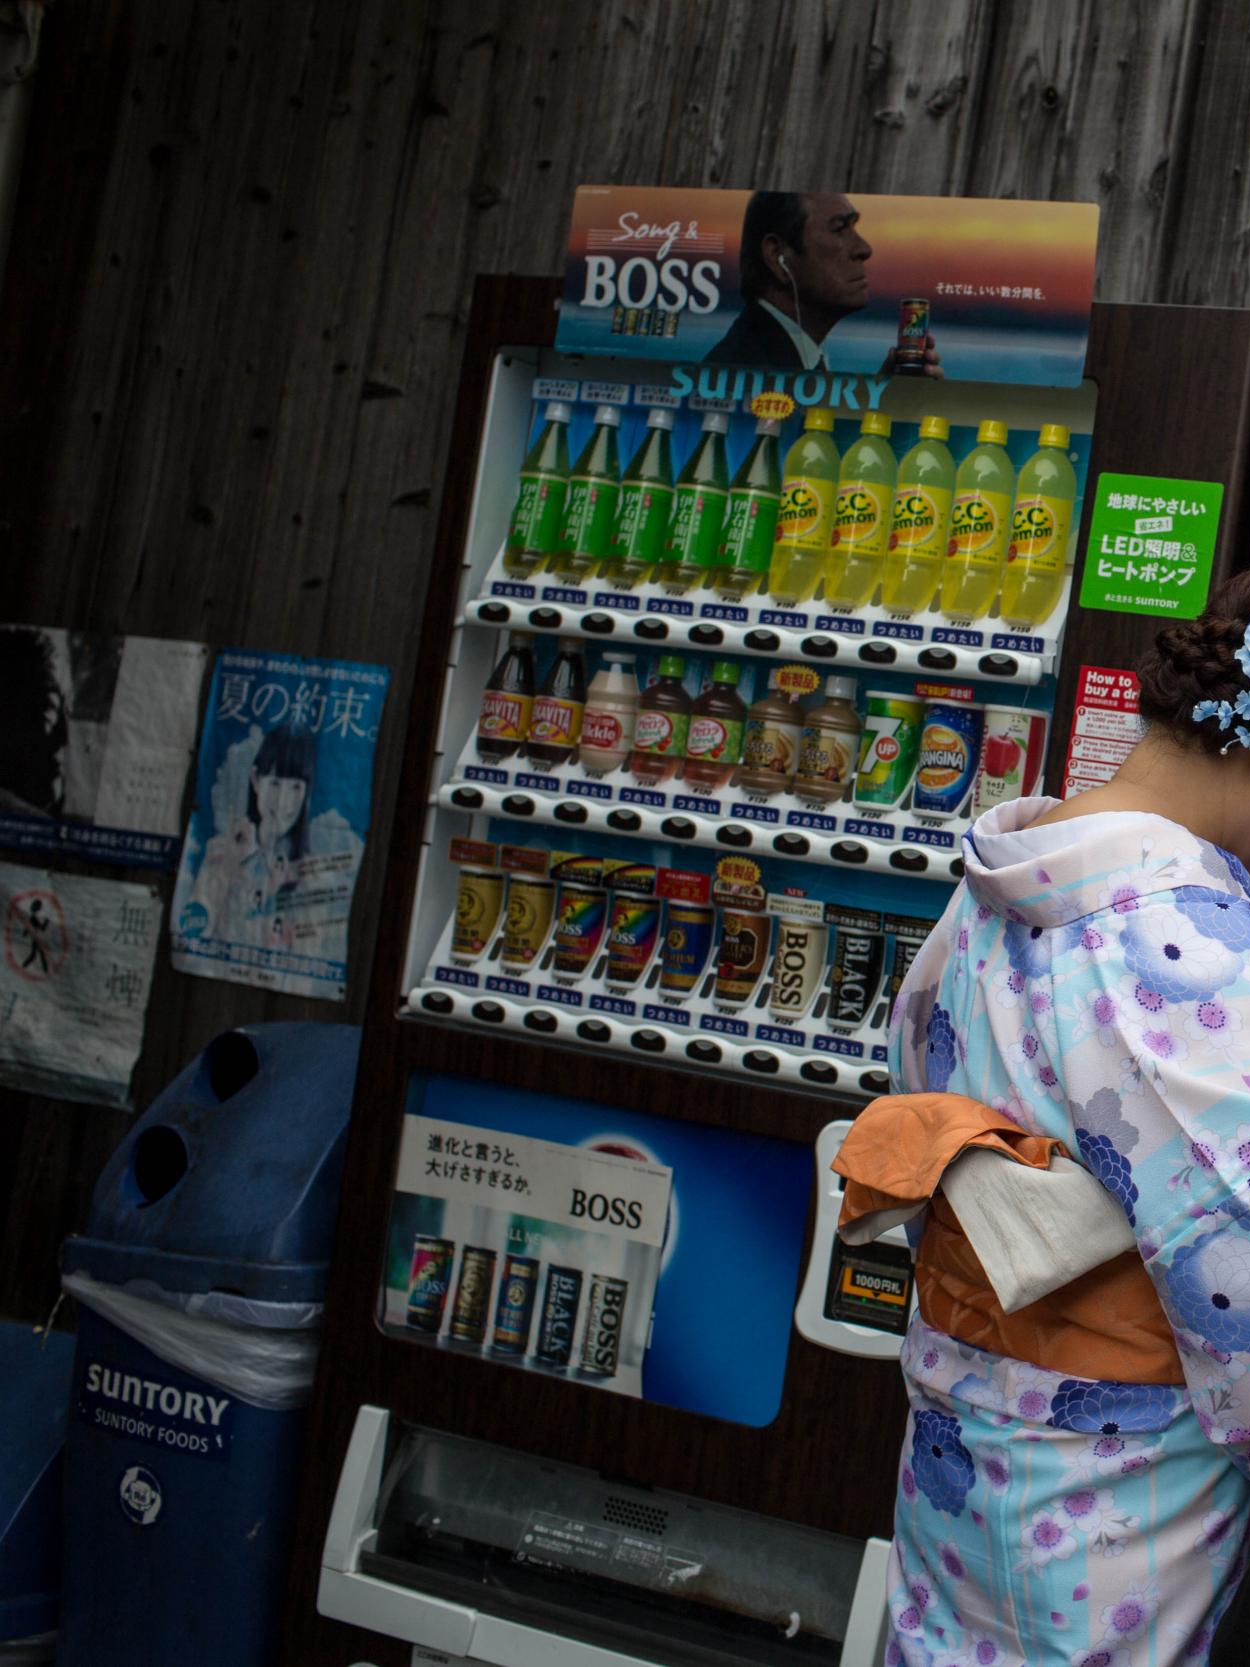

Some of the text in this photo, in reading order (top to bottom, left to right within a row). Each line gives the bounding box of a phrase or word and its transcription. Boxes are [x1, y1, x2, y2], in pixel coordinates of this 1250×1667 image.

[612, 210, 698, 260] Song &
[579, 254, 721, 314] BOSS
[669, 362, 891, 410] SUNTORY
[1107, 492, 1207, 516] 地球にやさしい
[1096, 558, 1197, 586] ヒートポンプ
[494, 583, 534, 598] つめたい
[546, 590, 583, 602] つめたい
[598, 596, 637, 609] つめたい
[651, 602, 690, 614] つめたい
[1135, 596, 1180, 610] SUNTORY
[705, 608, 745, 620] つめたい
[763, 613, 804, 626] つめたい
[820, 619, 861, 633] つめたい
[877, 625, 919, 638] つめたい
[936, 631, 979, 645] つめたい
[996, 637, 1040, 651] つめたい
[780, 671, 814, 689] 新製品
[1086, 670, 1132, 688] How to
[1084, 683, 1121, 699] buy a
[206, 672, 379, 741] 夏の約束。
[861, 716, 903, 774] 7
[876, 743, 897, 755] UP
[467, 768, 505, 783] つめたい
[518, 776, 557, 790] つめたい
[569, 783, 609, 798] つめたい
[623, 790, 663, 805] つめたい
[676, 798, 717, 813] つめたい
[735, 806, 776, 821] つめたい
[791, 814, 833, 829] つめたい
[848, 822, 891, 838] つめたい
[906, 830, 951, 846] つめたい
[438, 968, 476, 985] つめたい
[778, 930, 808, 1007] BOSS
[837, 935, 872, 1019] BLACK
[488, 979, 528, 994] つめたい
[540, 988, 580, 1004] つめたい
[593, 997, 632, 1014] つめたい
[647, 1007, 688, 1024] つめたい
[704, 1018, 745, 1034] つめたい
[759, 1028, 802, 1045] つめたい
[817, 1039, 860, 1055] つめたい
[427, 1133, 521, 1168] 進化と言うと、
[424, 1158, 532, 1196] 大げさすぎるか。
[570, 1188, 643, 1229] BOSS
[855, 1273, 902, 1295] 1000円札
[551, 1273, 577, 1362] BLACK
[595, 1284, 623, 1370] BOSS
[86, 1362, 230, 1426] SUNTORY
[95, 1406, 209, 1454] SUNTORY FOODS
